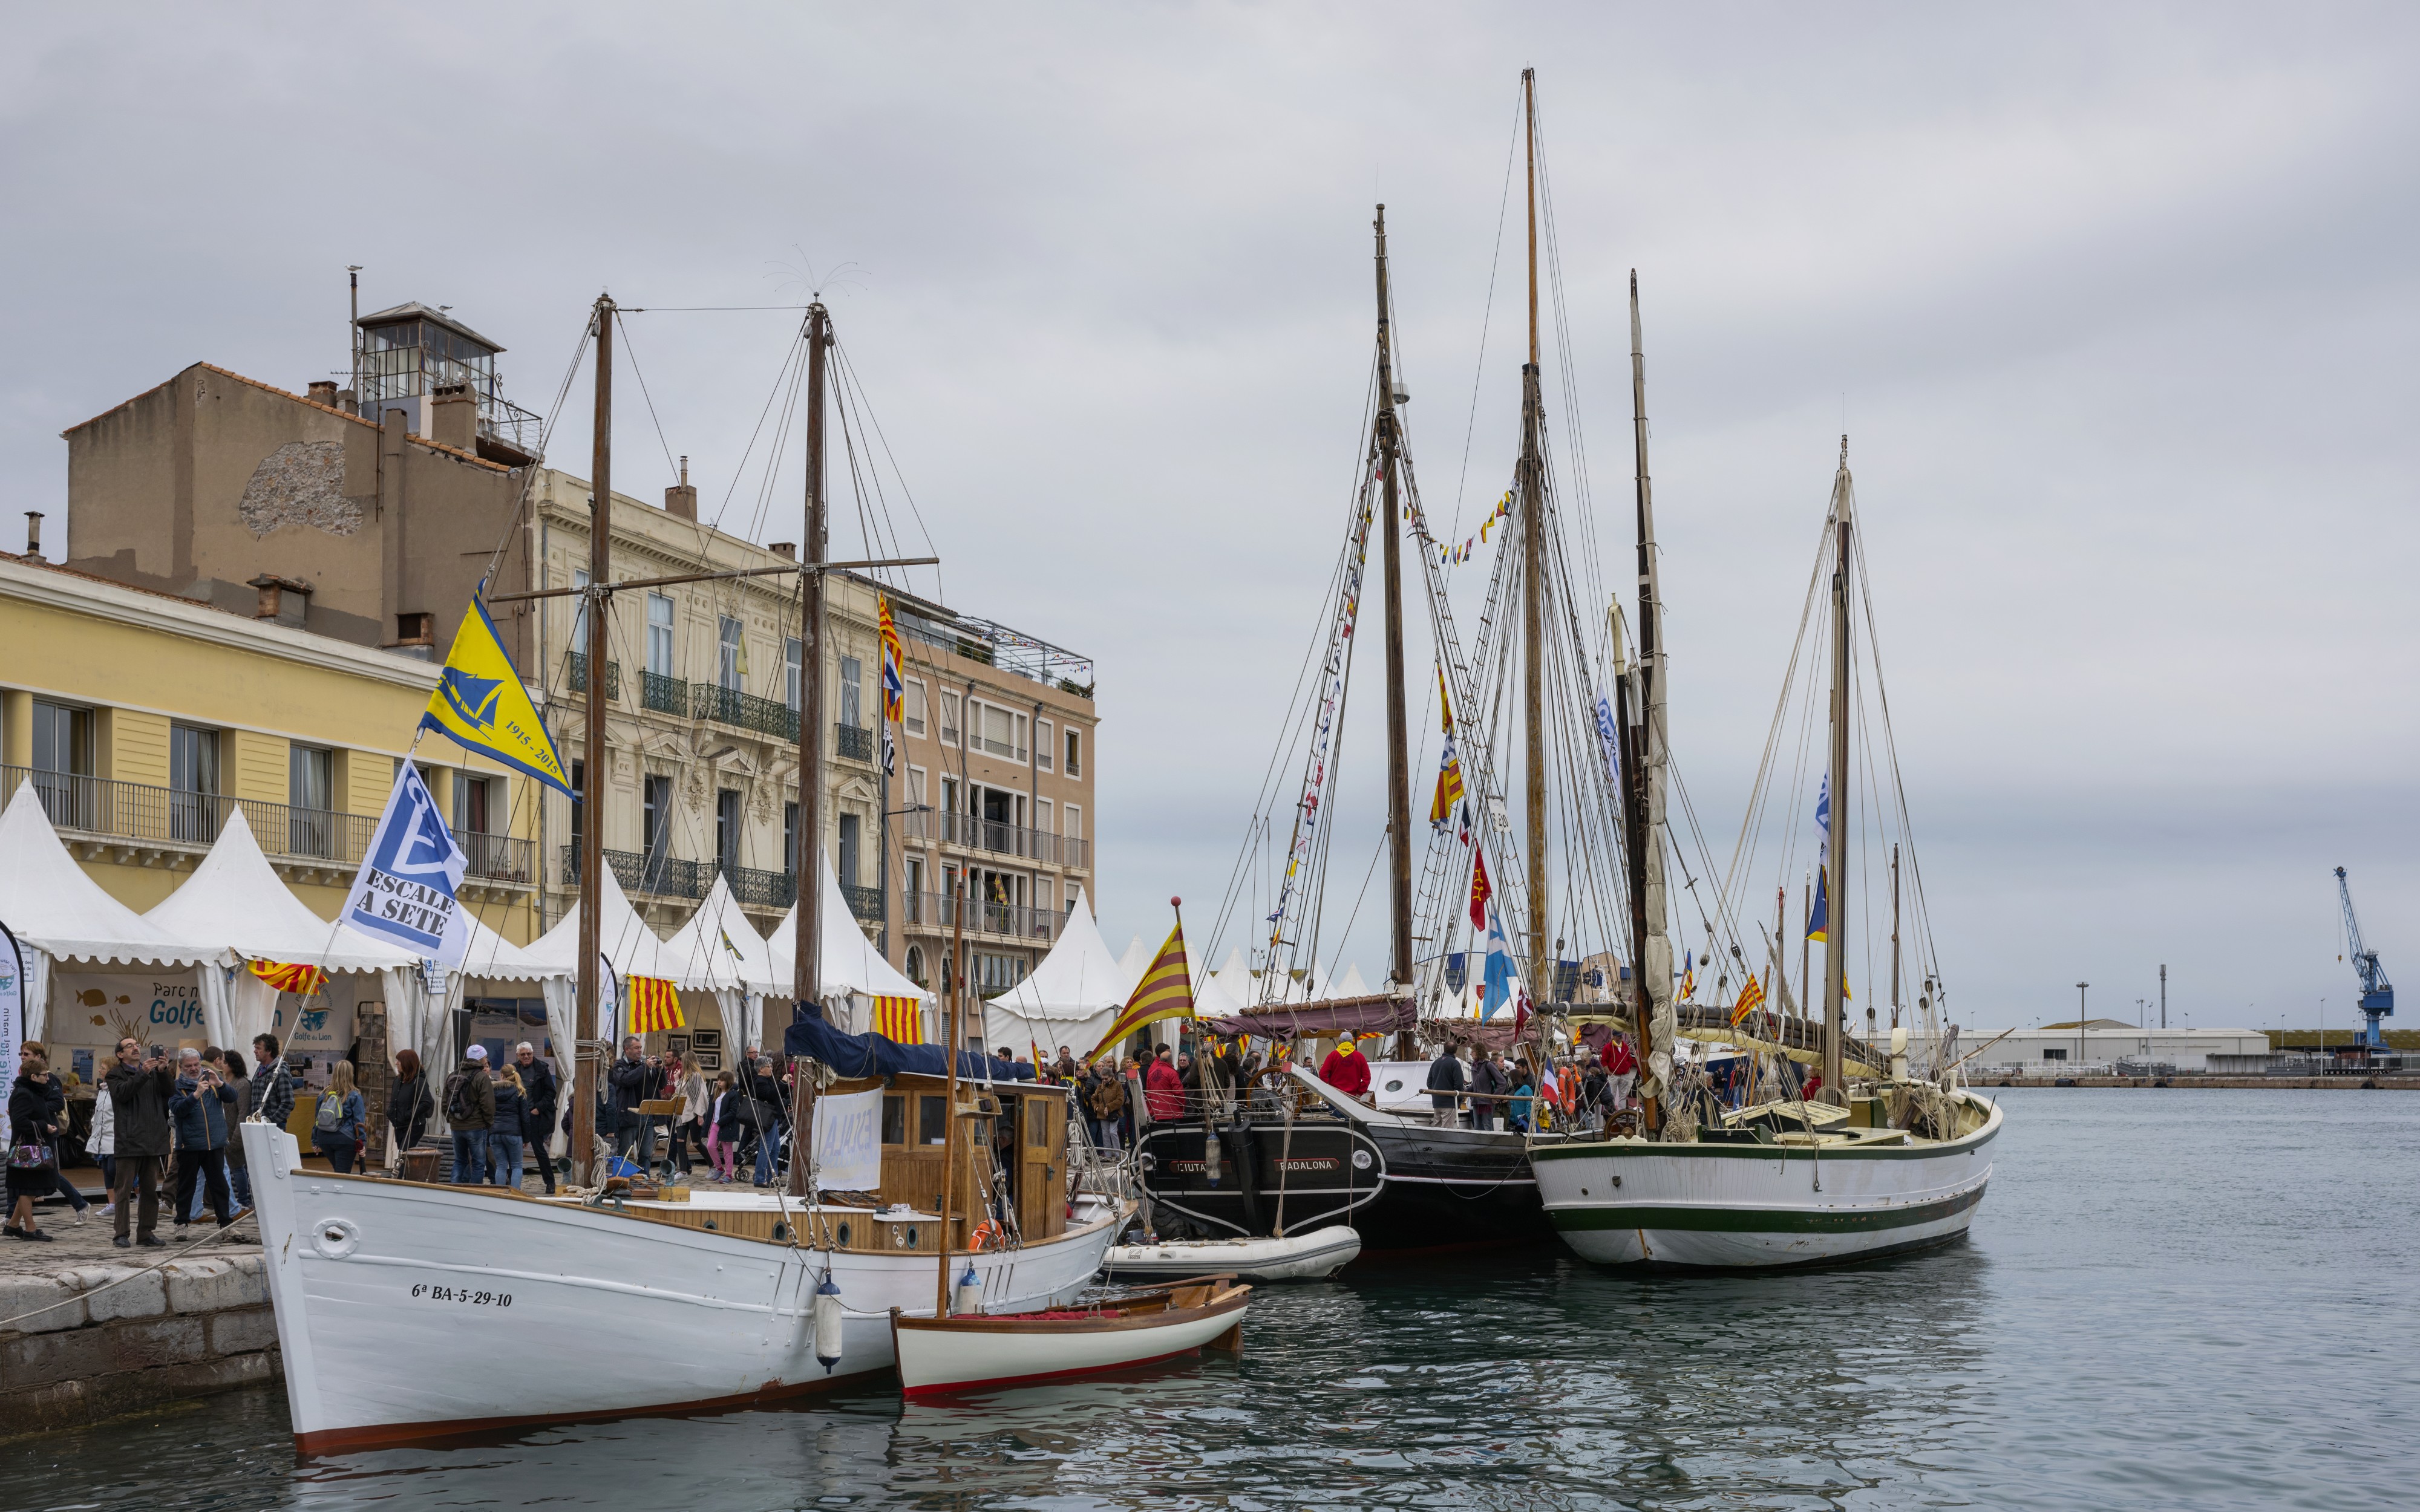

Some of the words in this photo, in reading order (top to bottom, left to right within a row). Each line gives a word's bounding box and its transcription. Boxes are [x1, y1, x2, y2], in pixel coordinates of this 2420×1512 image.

[506, 720, 531, 745] 1915
[534, 749, 558, 774] 2015
[365, 867, 455, 916] ESCALE
[356, 890, 374, 913] A
[381, 899, 448, 936] SETE
[153, 982, 185, 997] Parc
[150, 999, 204, 1029] Golfe
[294, 1032, 310, 1041] Golfe
[1177, 1163, 1206, 1171] CIUTA
[431, 1286, 512, 1307] BA-5-29-10
